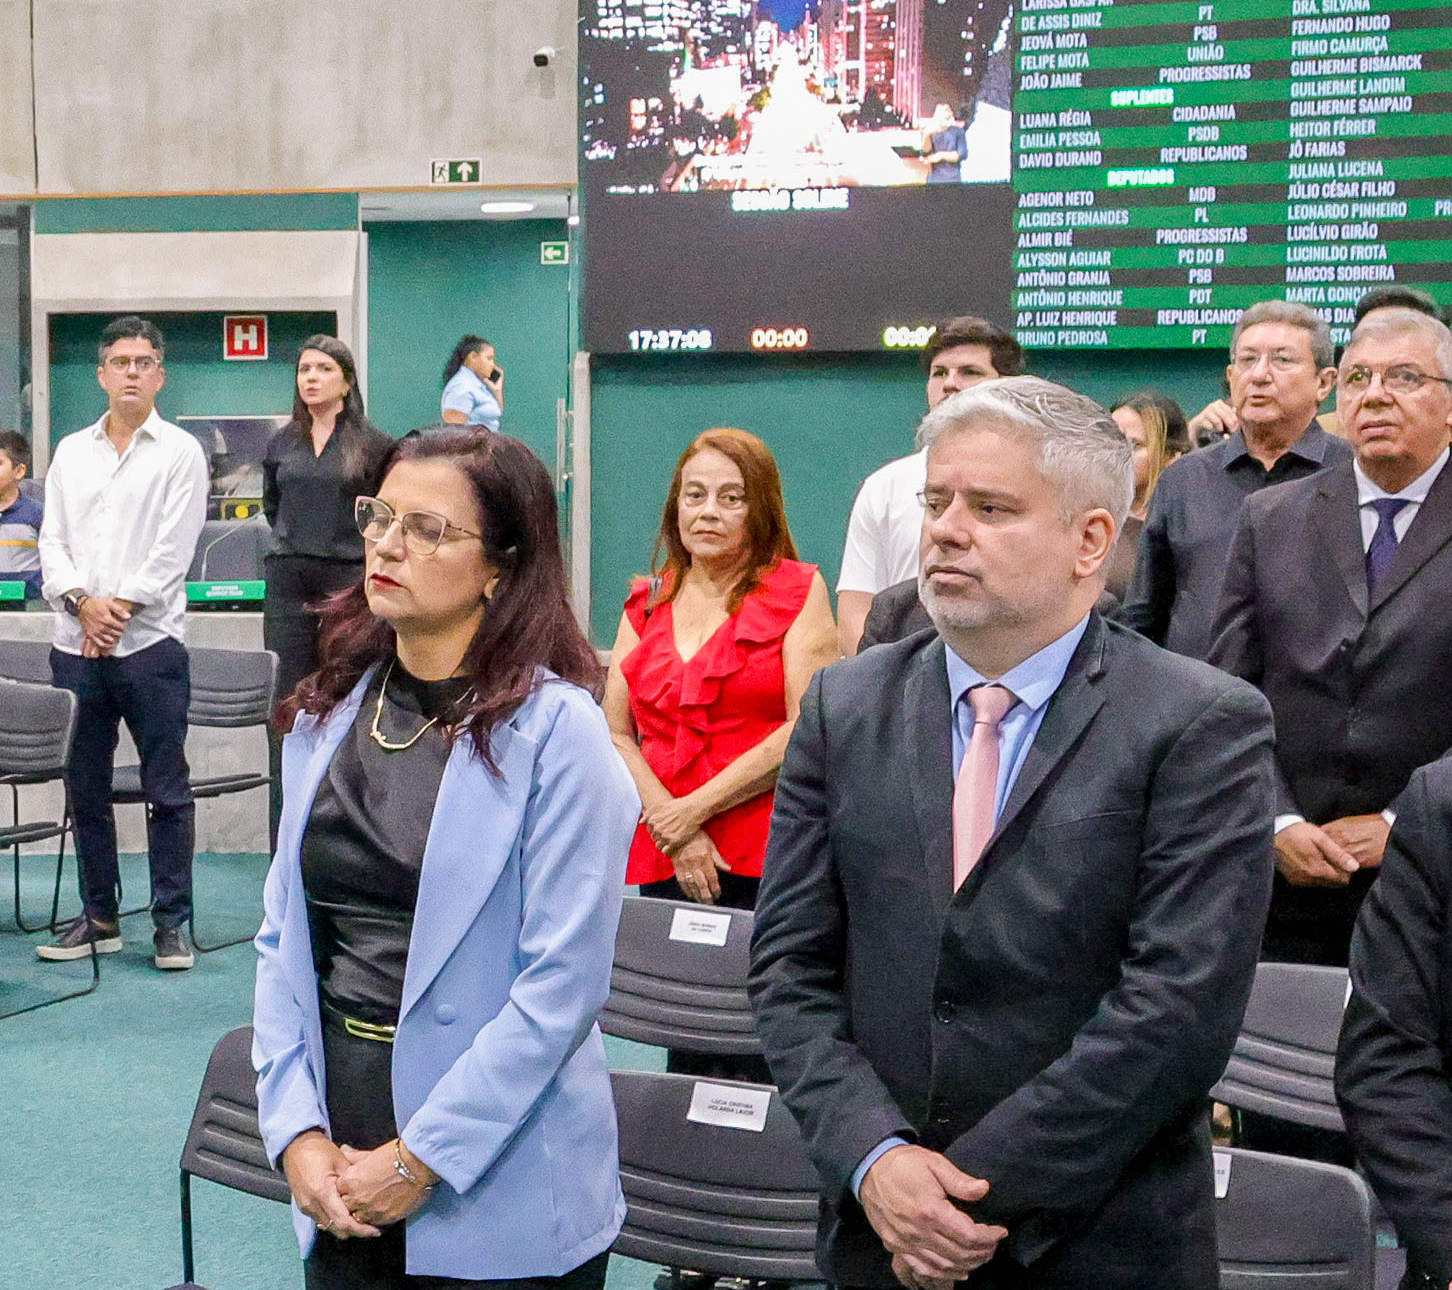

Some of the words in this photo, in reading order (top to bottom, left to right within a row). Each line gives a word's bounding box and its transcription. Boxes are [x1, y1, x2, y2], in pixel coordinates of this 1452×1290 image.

[1199, 6, 1213, 20] PT
[1293, 0, 1319, 14] DRA.
[1022, 16, 1035, 30] DE
[1037, 15, 1069, 29] ASSIS
[1072, 12, 1101, 27] DINIZ
[1292, 17, 1353, 34] FERNANDO
[1356, 15, 1390, 31] HUGO
[1021, 32, 1053, 50] JEOVÁ
[1056, 33, 1087, 48] MOTA
[1194, 25, 1217, 40] PSB
[1188, 44, 1223, 61] UNIÃO
[1292, 40, 1328, 54] FIRMO
[1330, 37, 1389, 55] CAMURÇA
[1022, 55, 1055, 70] FELIPE
[1058, 53, 1089, 67] MOTA
[1291, 58, 1357, 75] GUILHERME
[1359, 55, 1421, 72] BISMARCK
[1021, 72, 1048, 90] JOÃO
[1050, 73, 1082, 88] JAIME
[1160, 64, 1250, 82] PROGRESSISTAS
[1291, 80, 1356, 97] GUILHERME
[1360, 78, 1404, 93] LANDIM
[1173, 105, 1235, 121] CIDADANIA
[1291, 99, 1356, 117] GUILHERME
[1359, 96, 1412, 113] SAMPAIO
[1020, 113, 1057, 128] LUANA
[1059, 109, 1091, 126] RÉGIA
[1290, 122, 1330, 137] HEITOR
[1333, 117, 1375, 135] FÉRRER
[1056, 131, 1100, 146] PESSOA
[1189, 126, 1219, 141] PSDB
[1161, 145, 1247, 162] REPUBLICANOS
[1305, 141, 1345, 157] FARIAS
[1020, 153, 1052, 168] DAVID
[1054, 151, 1101, 166] DURAND
[1289, 163, 1336, 179] JULIANA
[1337, 161, 1383, 176] LUCENA
[1190, 187, 1215, 202] MDB
[1288, 182, 1319, 199] JÚLIO
[1322, 179, 1359, 197] CÉSAR
[1361, 181, 1395, 196] FILHO
[1019, 192, 1063, 207] AGENOR
[1065, 191, 1093, 205] NETO
[1019, 212, 1064, 227] ALCIDES
[1066, 210, 1128, 225] FERNANDES
[1195, 208, 1208, 222] PL
[1288, 204, 1348, 219] LEONARDO
[1352, 202, 1406, 217] PINHEIRO
[1018, 233, 1053, 247] ALMIR
[1055, 229, 1072, 246] BIÉ
[1157, 228, 1247, 243] PROGRESSISTAS
[1288, 224, 1339, 240] LUCÍLVIO
[1341, 221, 1378, 239] GIRÃO
[1018, 252, 1067, 267] ALYSSON
[1069, 251, 1110, 265] AGUIAR
[1287, 246, 1347, 261] LUCINILDO
[1351, 245, 1386, 259] FROTA
[1018, 270, 1065, 287] ANTÔNIO
[1068, 271, 1110, 285] GRANJA
[1189, 269, 1211, 283] PSB
[1287, 267, 1335, 281] MARCOS
[1337, 265, 1394, 280] SOBREIRA
[1018, 289, 1065, 305] ANTÔNIO
[1068, 291, 1122, 305] HENRIQUE
[1190, 289, 1212, 303] PDT
[1286, 288, 1325, 302] MARTA
[1036, 312, 1060, 326] LUIZ
[1062, 311, 1116, 325] HENRIQUE
[234, 324, 258, 351] H
[752, 328, 807, 347] 00:00
[1018, 332, 1055, 344] BRUNO
[1058, 331, 1107, 344] PEDROSA
[1193, 330, 1206, 343] PT
